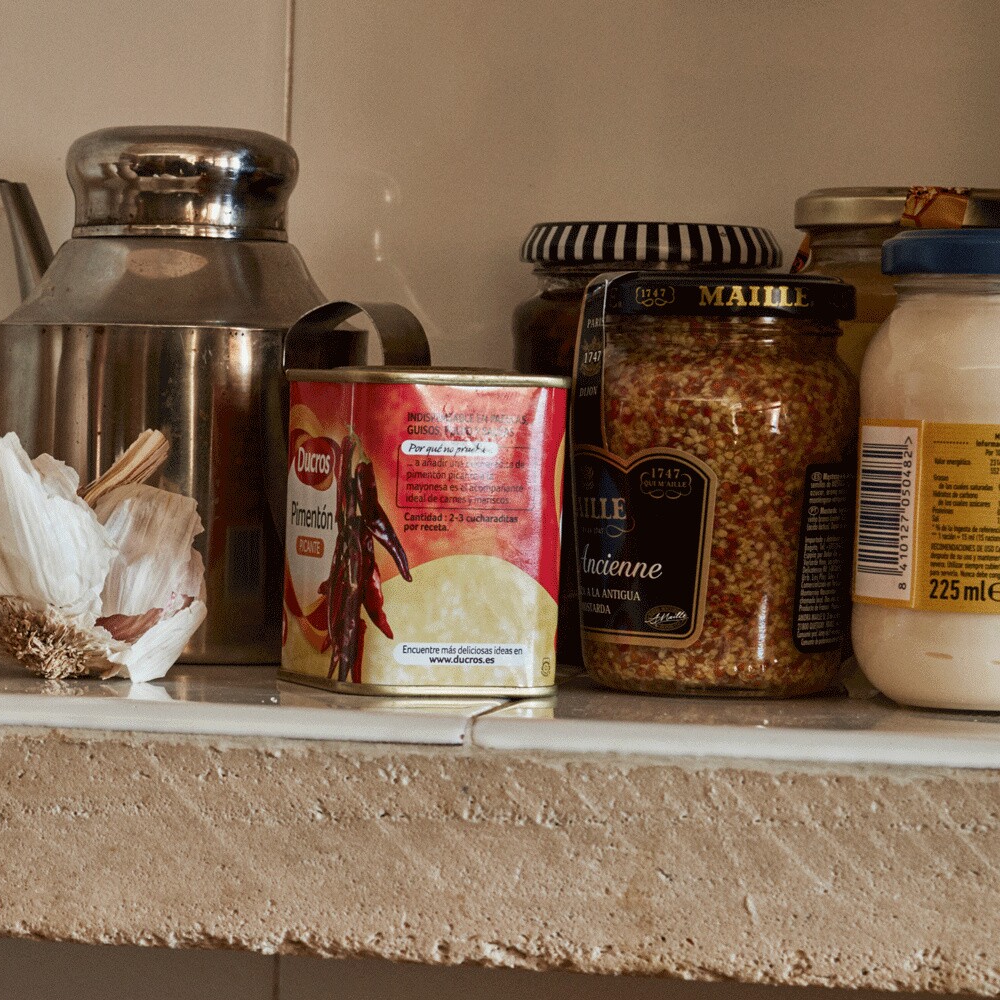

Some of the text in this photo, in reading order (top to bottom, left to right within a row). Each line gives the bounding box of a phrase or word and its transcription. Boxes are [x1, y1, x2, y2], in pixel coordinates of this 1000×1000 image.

[641, 288, 667, 298] 1747
[699, 285, 810, 307] MAILLE
[586, 317, 604, 329] PARI
[584, 350, 602, 364] 1747
[407, 411, 475, 424] INDISPABLE
[408, 442, 426, 453] Por
[426, 443, 442, 456] qué
[443, 446, 455, 454] no
[297, 446, 331, 474] Ducros
[421, 458, 447, 468] añadir
[651, 467, 680, 479] 1747
[405, 482, 447, 493] mayonesa
[405, 493, 426, 503] ideal
[427, 494, 438, 503] de
[291, 500, 333, 530] Pimentón
[403, 512, 443, 522] Cantidad
[449, 513, 464, 522] 2-3
[465, 514, 519, 523] cucharaditas
[403, 524, 449, 533] por receta.
[298, 539, 322, 555] PICANTE
[601, 588, 641, 601] ANTIGUA
[929, 578, 986, 602] 225 ml
[402, 644, 523, 656] Encuentre más deliciosas ideas en
[429, 654, 495, 664] www.ducros.es
